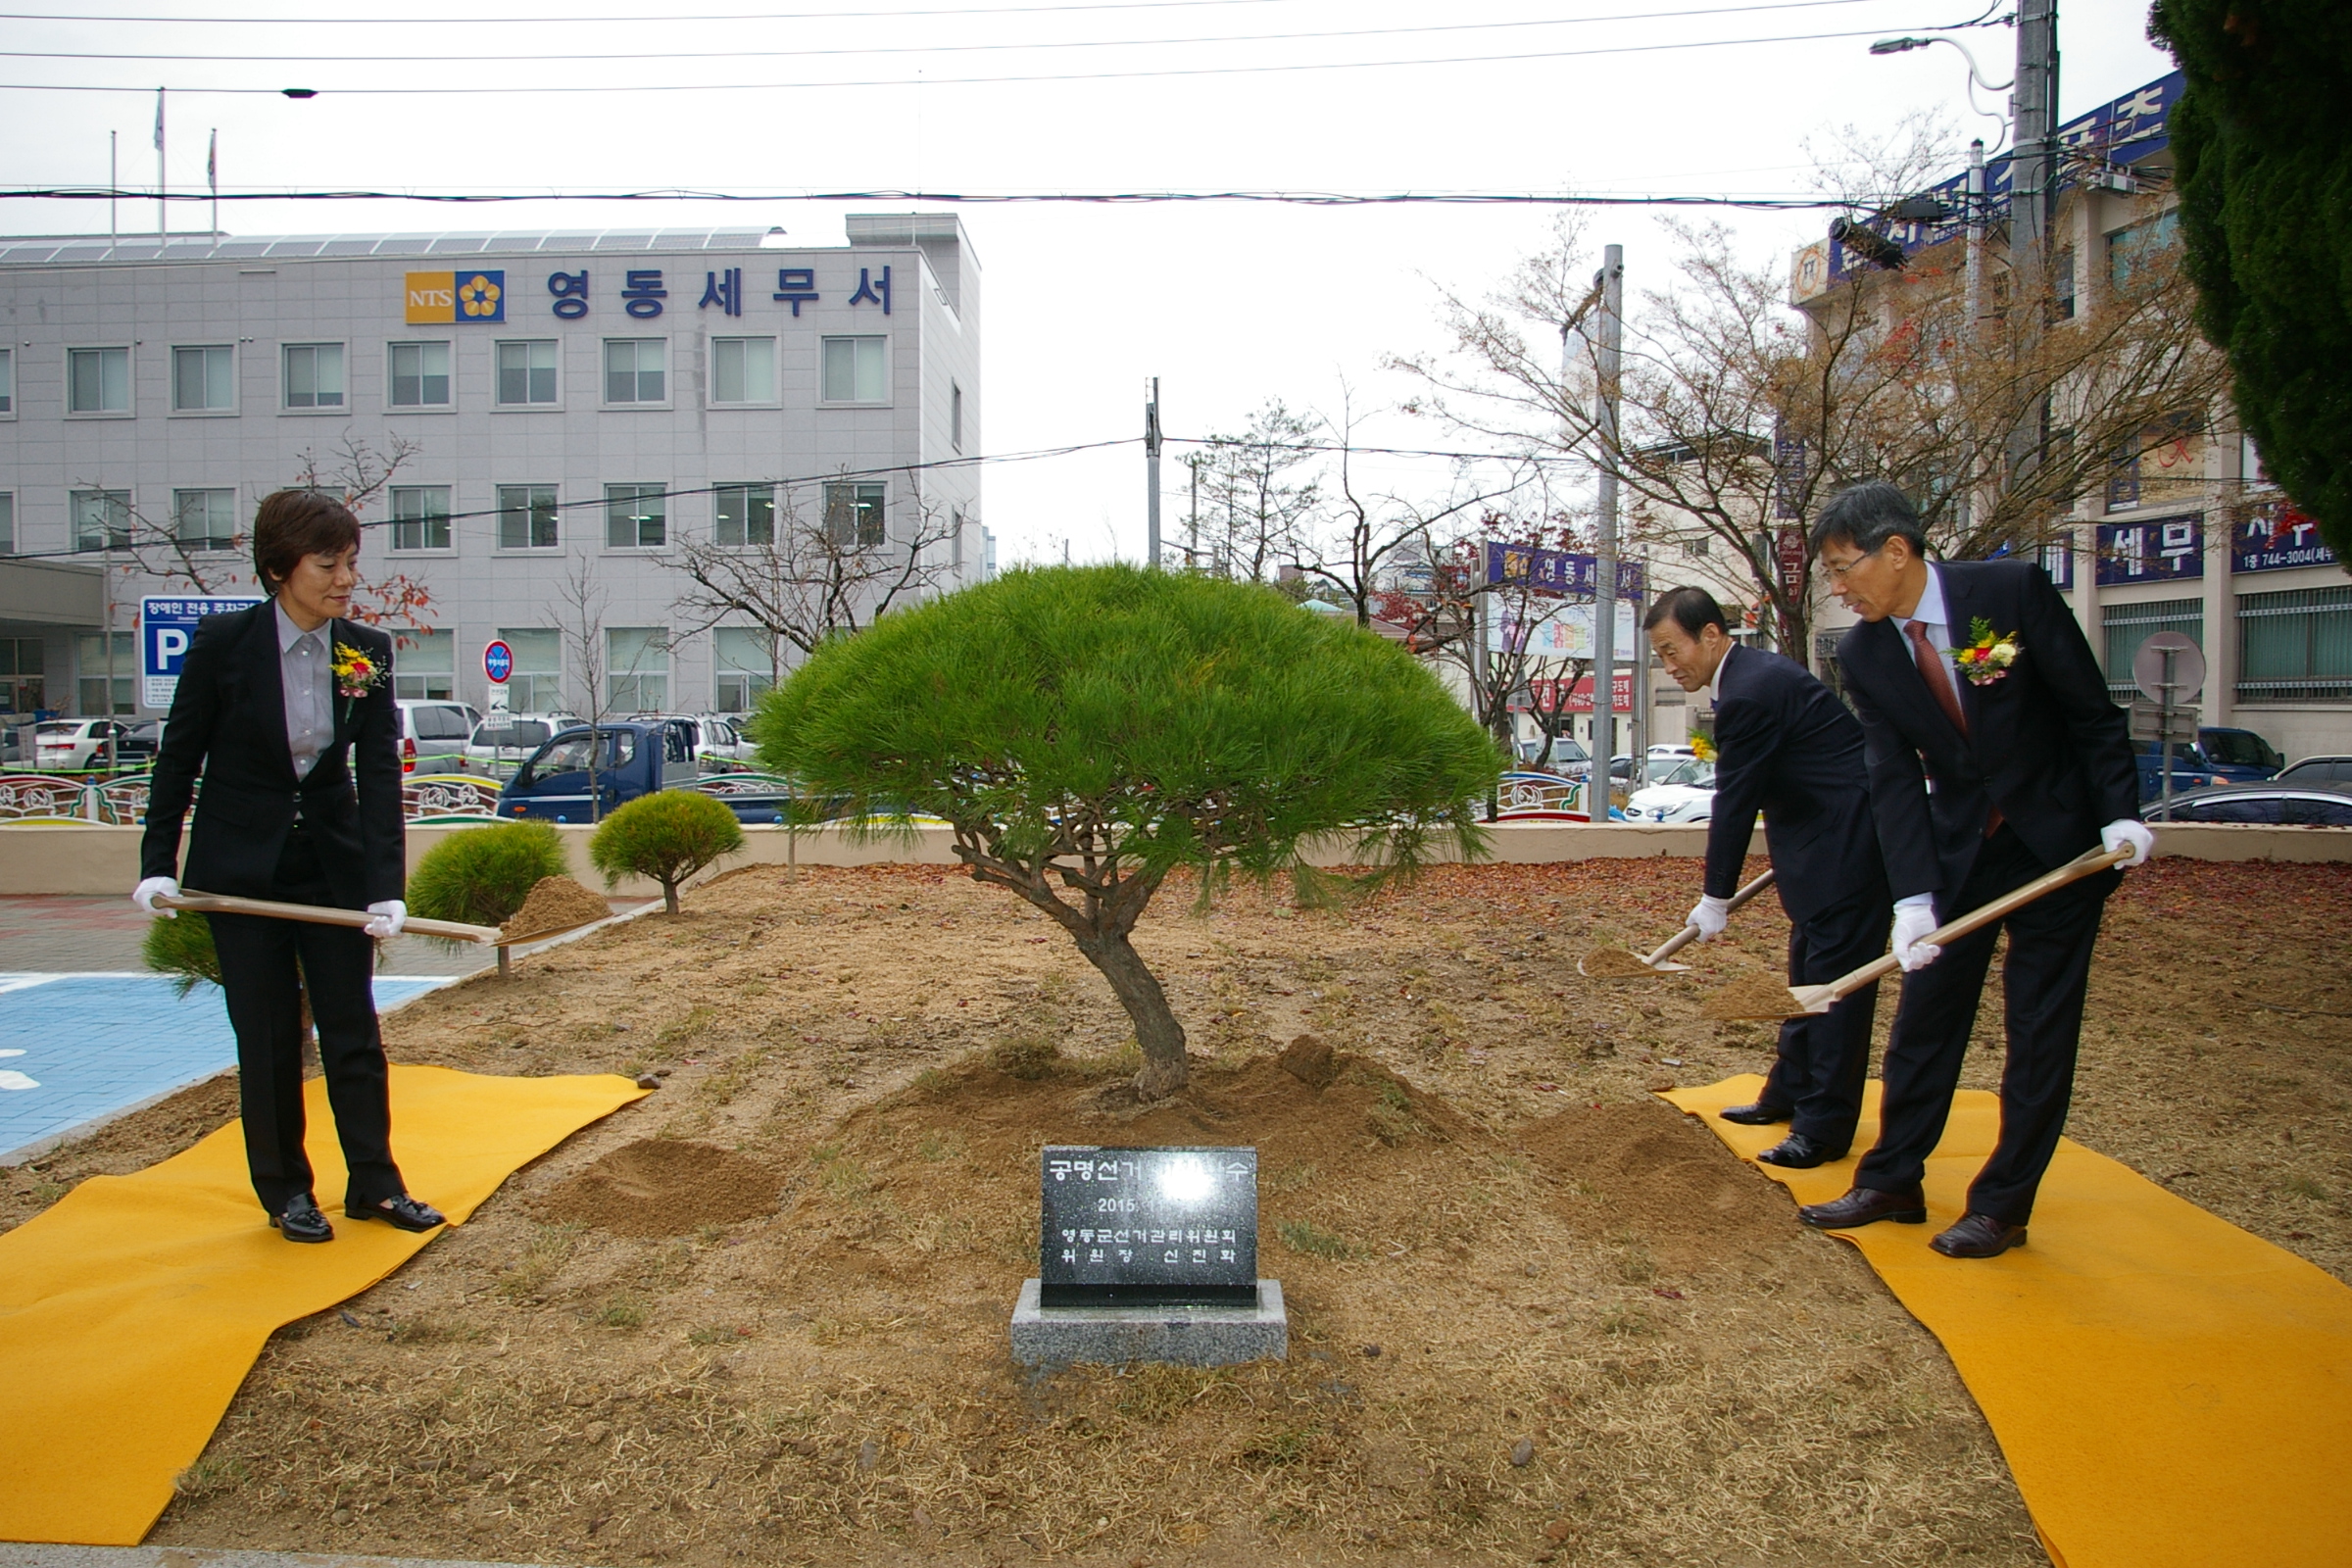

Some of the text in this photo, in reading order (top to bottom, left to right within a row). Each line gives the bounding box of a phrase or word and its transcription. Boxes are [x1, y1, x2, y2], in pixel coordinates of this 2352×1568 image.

[409, 289, 453, 308] NTS
[547, 266, 892, 319] 영동세무서
[1544, 558, 1632, 593] 영동세서
[147, 602, 183, 615] 장애인
[186, 602, 211, 615] 전용
[156, 628, 189, 670] P
[1049, 1159, 1142, 1182] 공명선거
[1061, 1228, 1237, 1244] 영동군선거관리위원회
